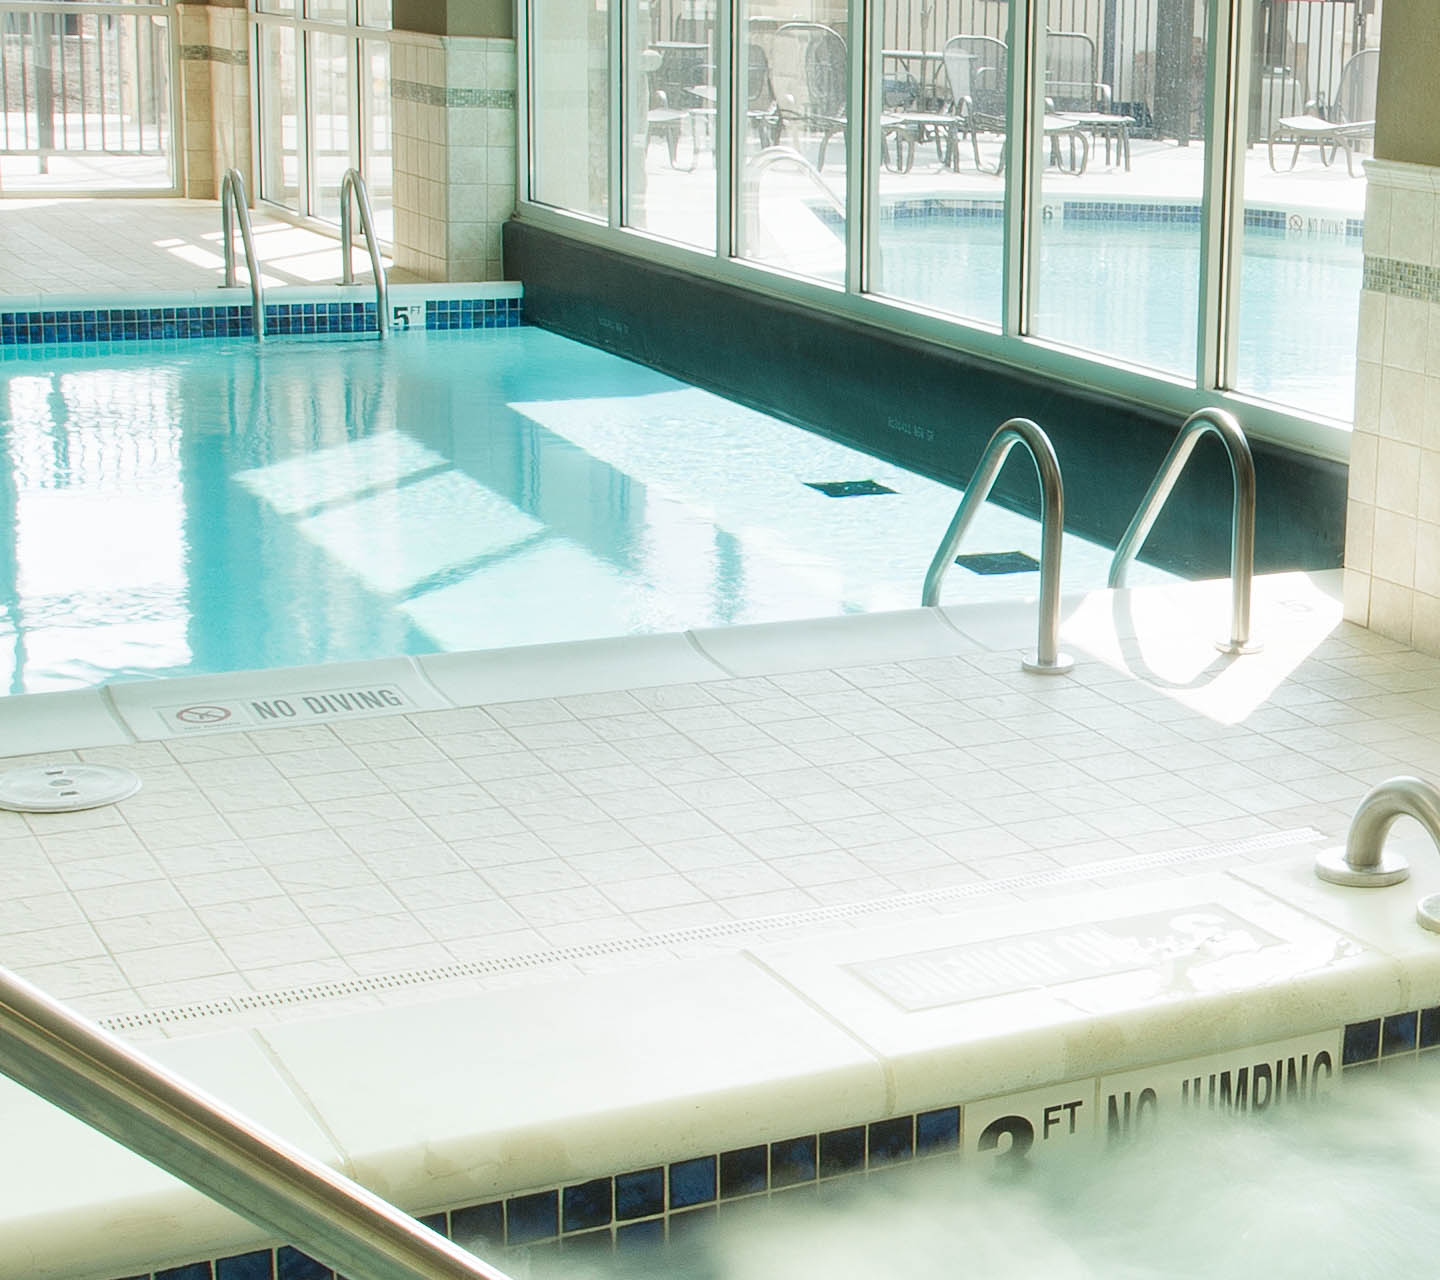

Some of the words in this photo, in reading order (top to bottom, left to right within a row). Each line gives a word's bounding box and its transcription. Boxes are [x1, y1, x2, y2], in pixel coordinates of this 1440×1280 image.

[393, 306, 410, 331] 5
[251, 699, 297, 720] NO
[302, 688, 404, 715] DIVING
[1043, 1100, 1084, 1140] FT
